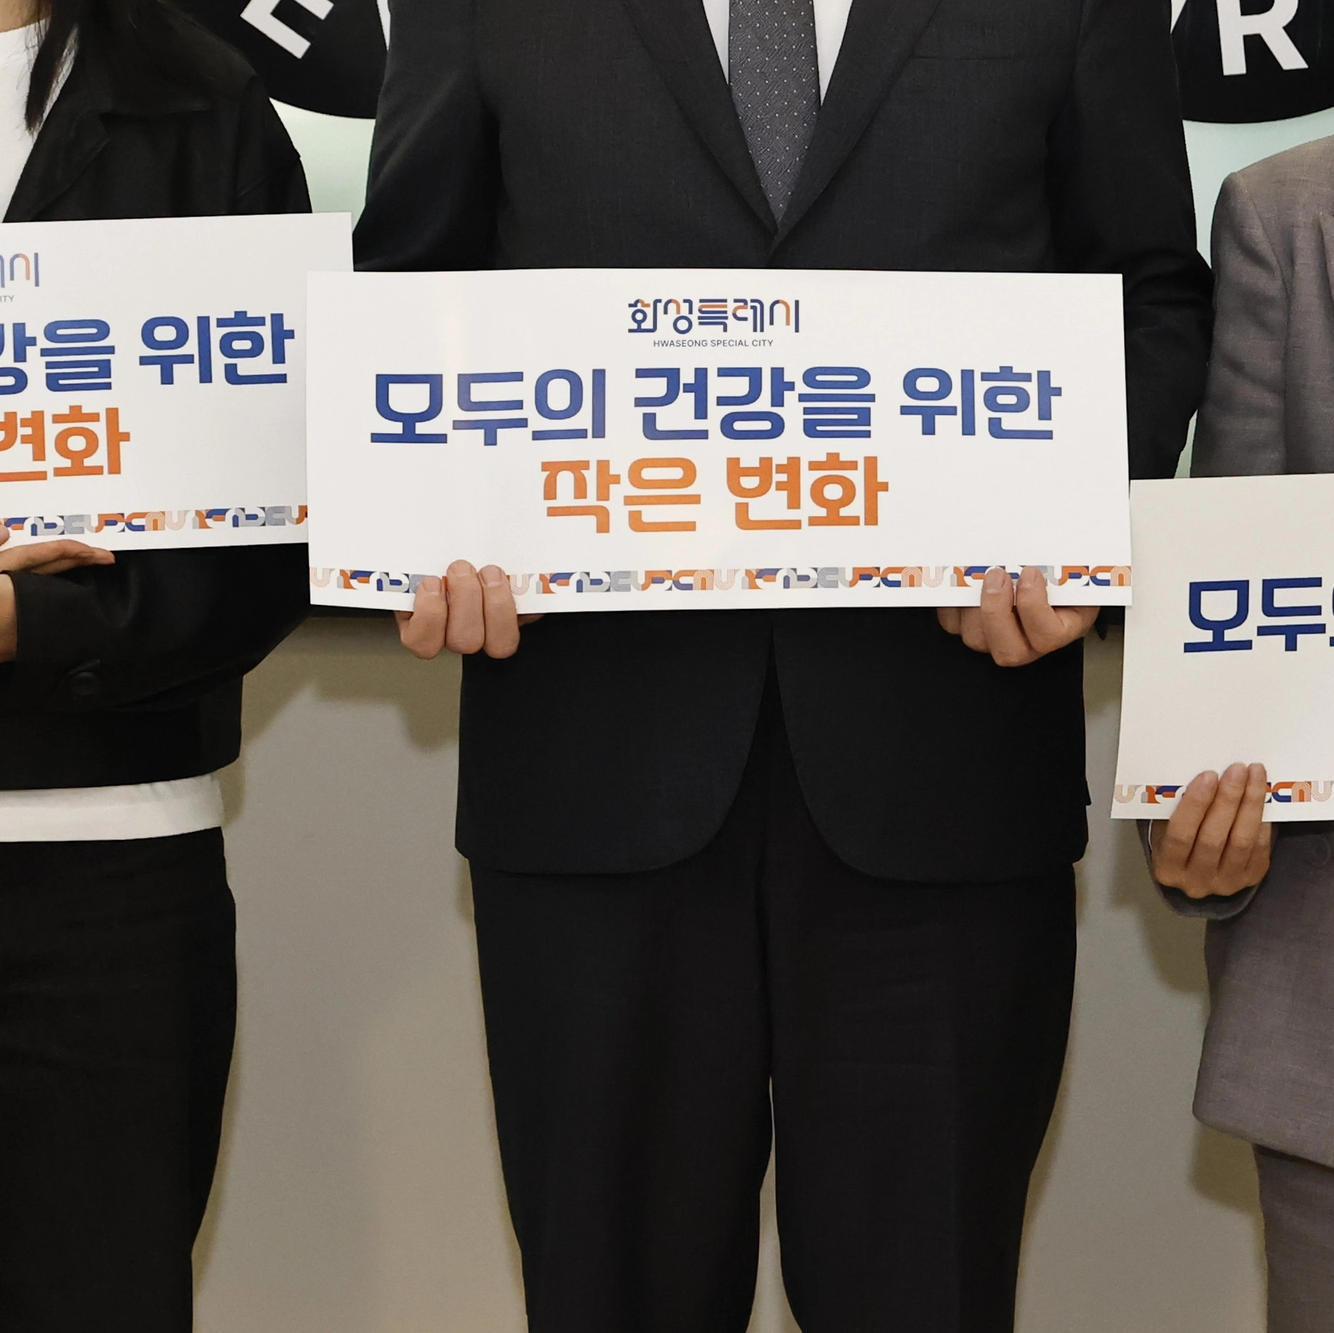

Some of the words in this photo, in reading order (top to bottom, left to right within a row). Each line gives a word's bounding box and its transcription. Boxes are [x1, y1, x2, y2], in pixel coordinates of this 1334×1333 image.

[139, 310, 295, 386] 위한
[628, 298, 800, 335] 화성특례시
[653, 339, 708, 348] HWASEONG
[710, 339, 750, 347] SPECIAL
[751, 339, 774, 347] CITY
[370, 368, 606, 447] 모두의
[633, 365, 876, 441] 건강을
[899, 365, 1062, 441] 위한
[541, 456, 702, 534] 작은
[725, 452, 890, 532] 변화
